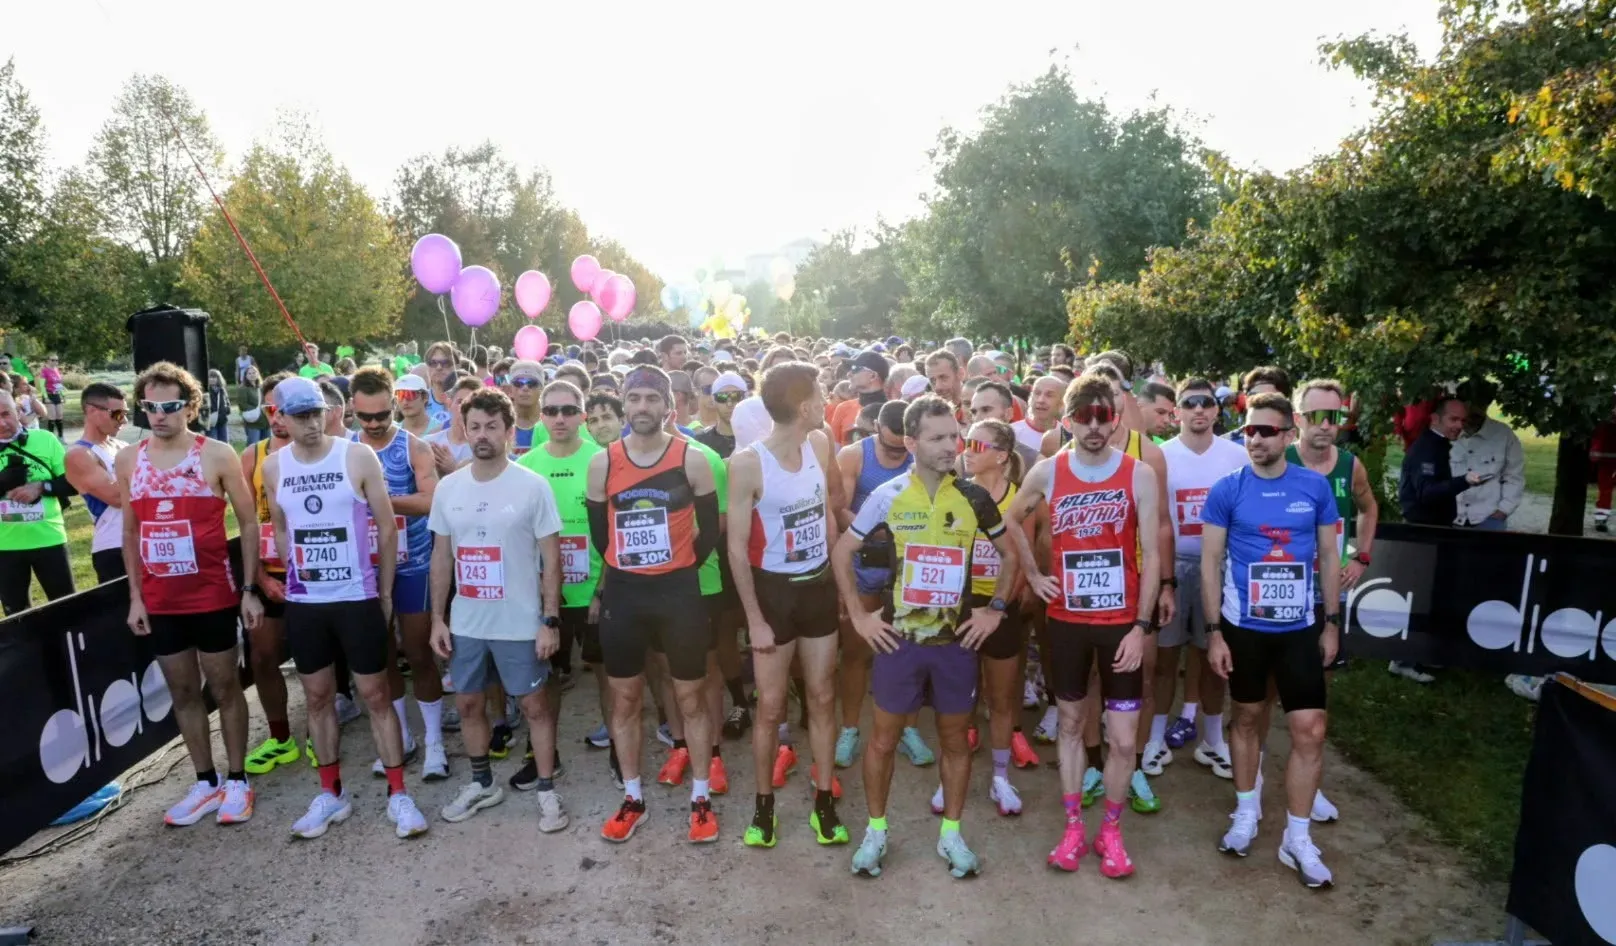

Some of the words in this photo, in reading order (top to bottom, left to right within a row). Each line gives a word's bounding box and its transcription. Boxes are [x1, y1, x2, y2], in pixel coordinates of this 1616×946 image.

[283, 472, 343, 488] RUNNERS
[292, 483, 335, 493] LEGNANO
[1057, 490, 1124, 509] ATLETICA
[625, 529, 657, 547] 2685
[795, 524, 821, 546] 2430
[1078, 527, 1101, 538] 1972
[153, 543, 176, 557] 199
[305, 547, 337, 562] 2740
[639, 550, 669, 564] 30K
[167, 562, 194, 574] 21K
[319, 568, 349, 580] 30K
[465, 565, 487, 580] 243
[921, 567, 945, 584] 521
[1078, 571, 1110, 588] 2742
[477, 586, 502, 599] 21K
[929, 591, 958, 605] 21K
[1262, 583, 1295, 599] 2303
[1090, 594, 1122, 608] 30K
[1274, 606, 1303, 619] 30K
